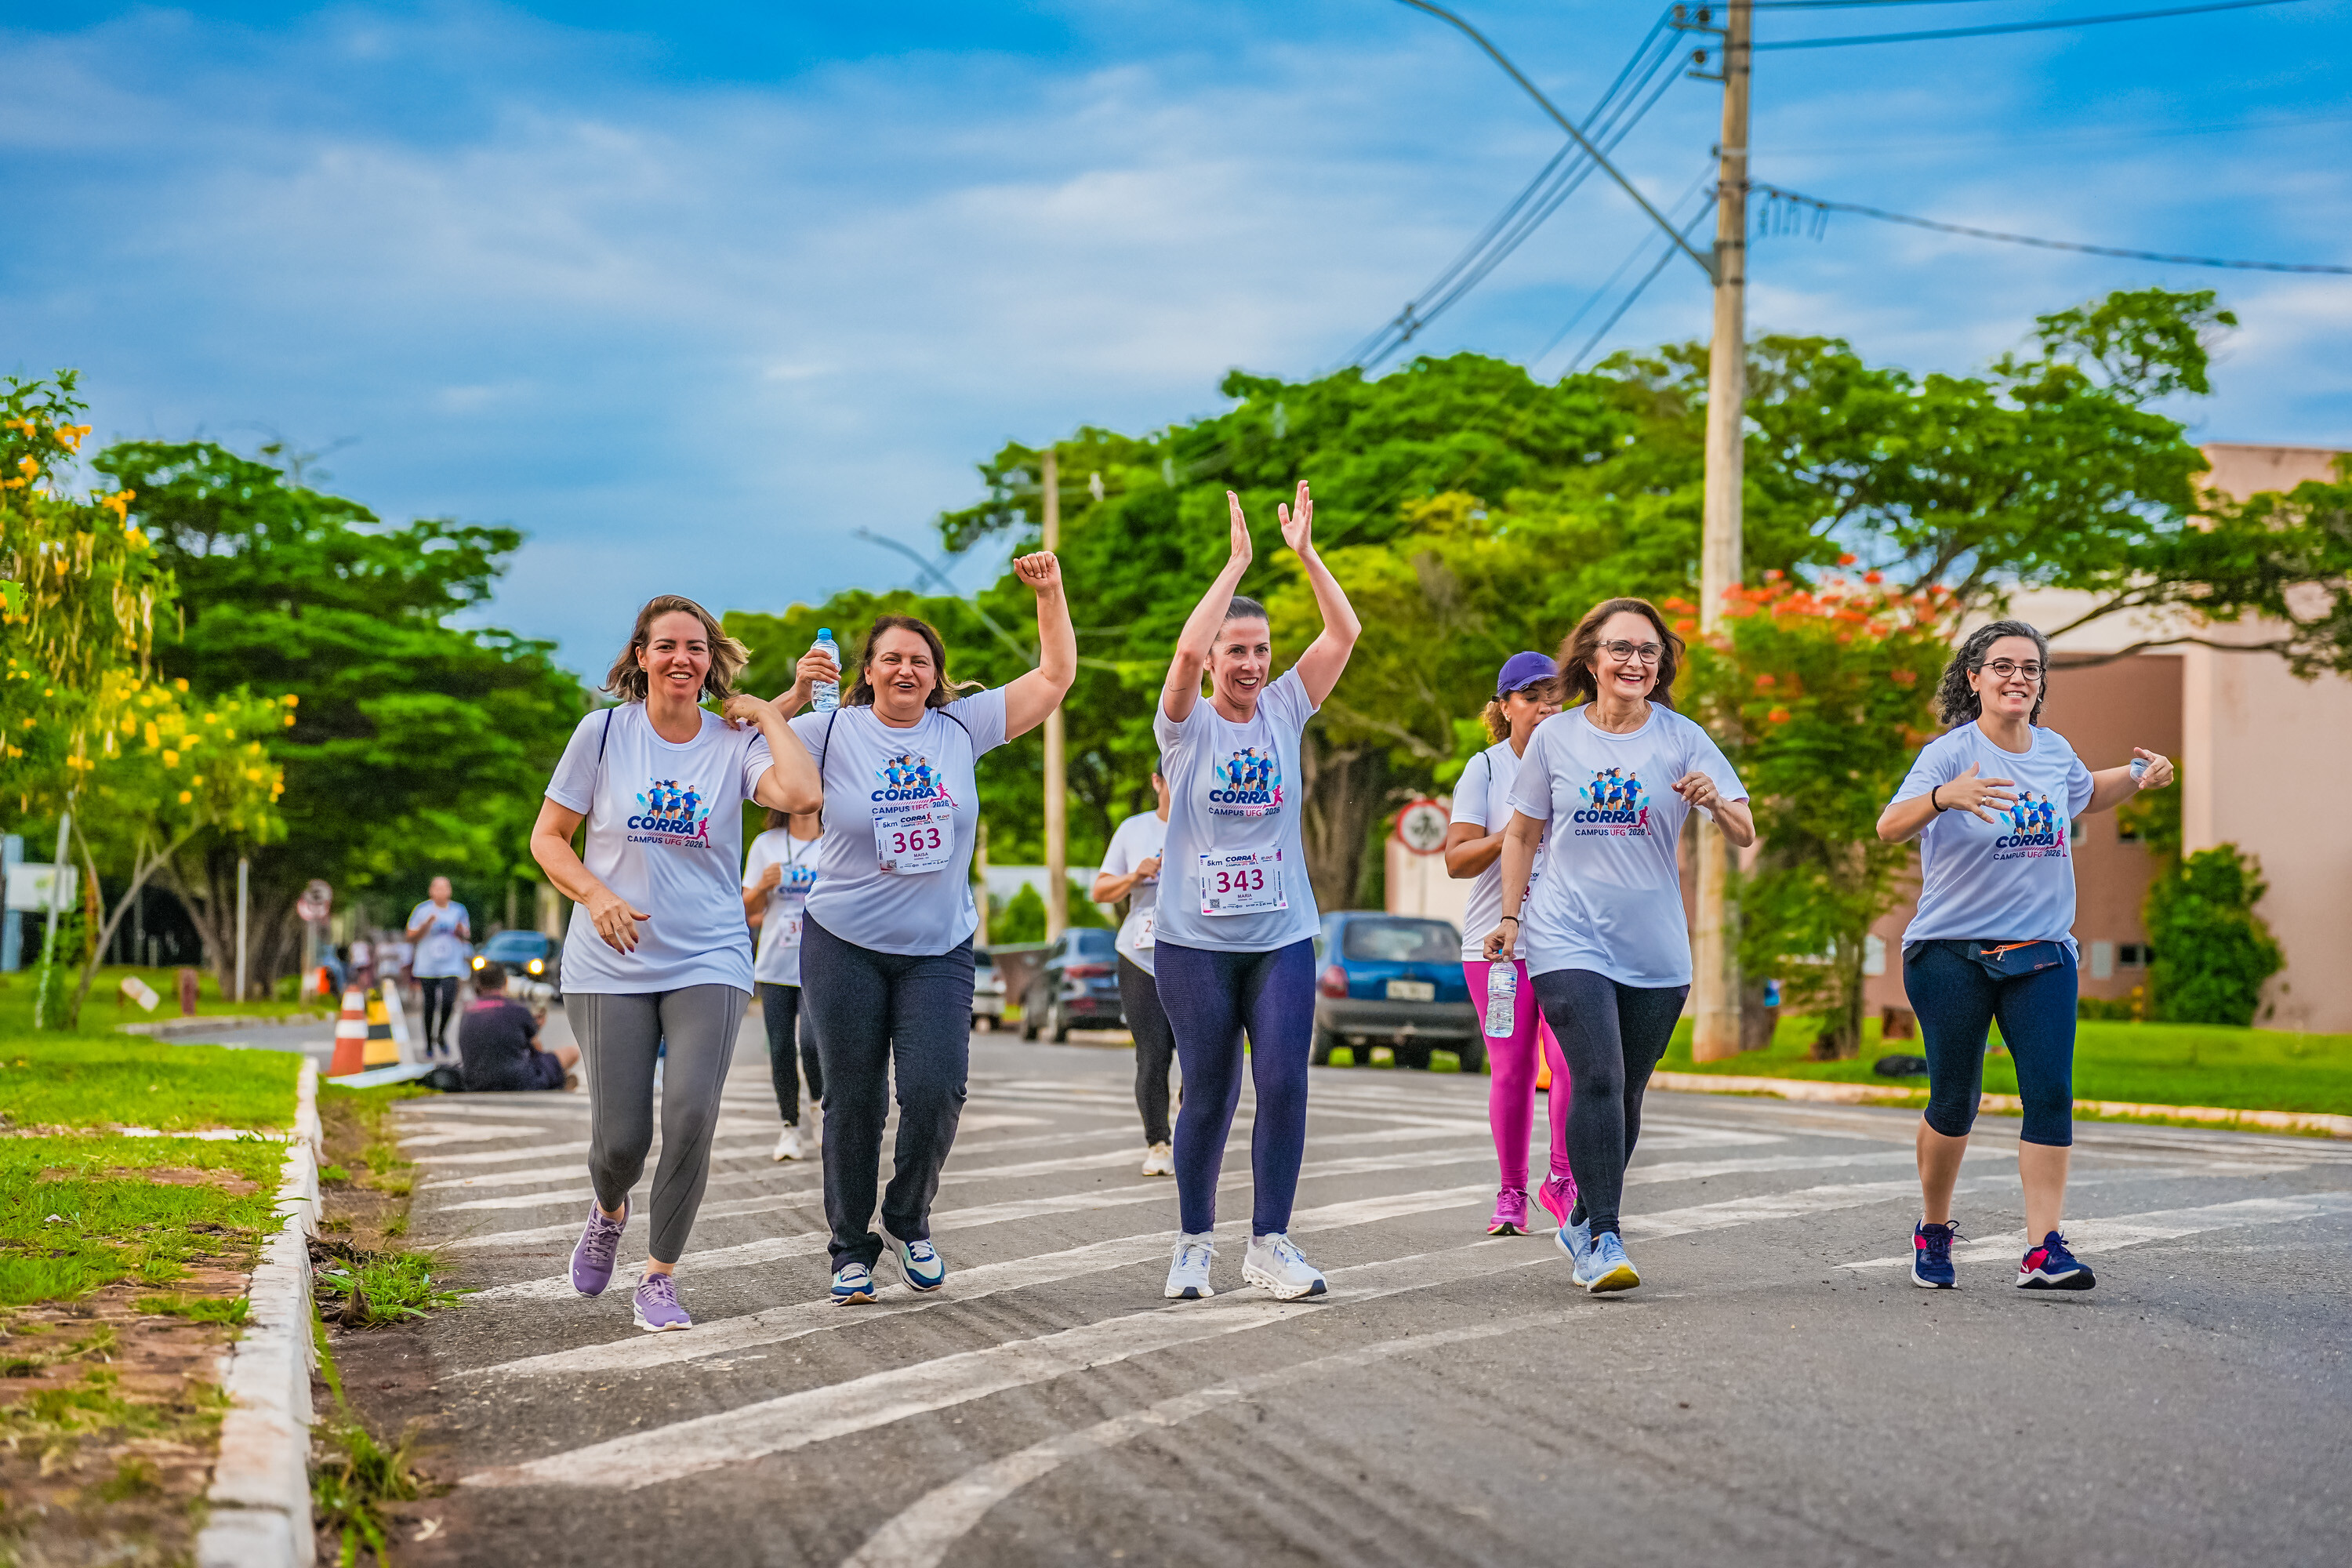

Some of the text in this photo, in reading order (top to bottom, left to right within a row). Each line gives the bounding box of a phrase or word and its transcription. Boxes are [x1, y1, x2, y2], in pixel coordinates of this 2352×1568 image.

[871, 787, 937, 802] CORRA
[1209, 789, 1271, 804] CORRA
[872, 805, 909, 814] CAMPUS
[1208, 807, 1244, 816] CAMPUS
[1265, 807, 1280, 815] 2026
[1573, 810, 1636, 823] CORRA
[627, 815, 695, 835] CORRA
[627, 835, 663, 844] CAMPUS
[684, 840, 704, 848] 2026
[892, 827, 941, 853] 363
[1995, 833, 2054, 848] CORRA
[1993, 851, 2025, 861] CAMPUS
[1216, 868, 1264, 893] 343
